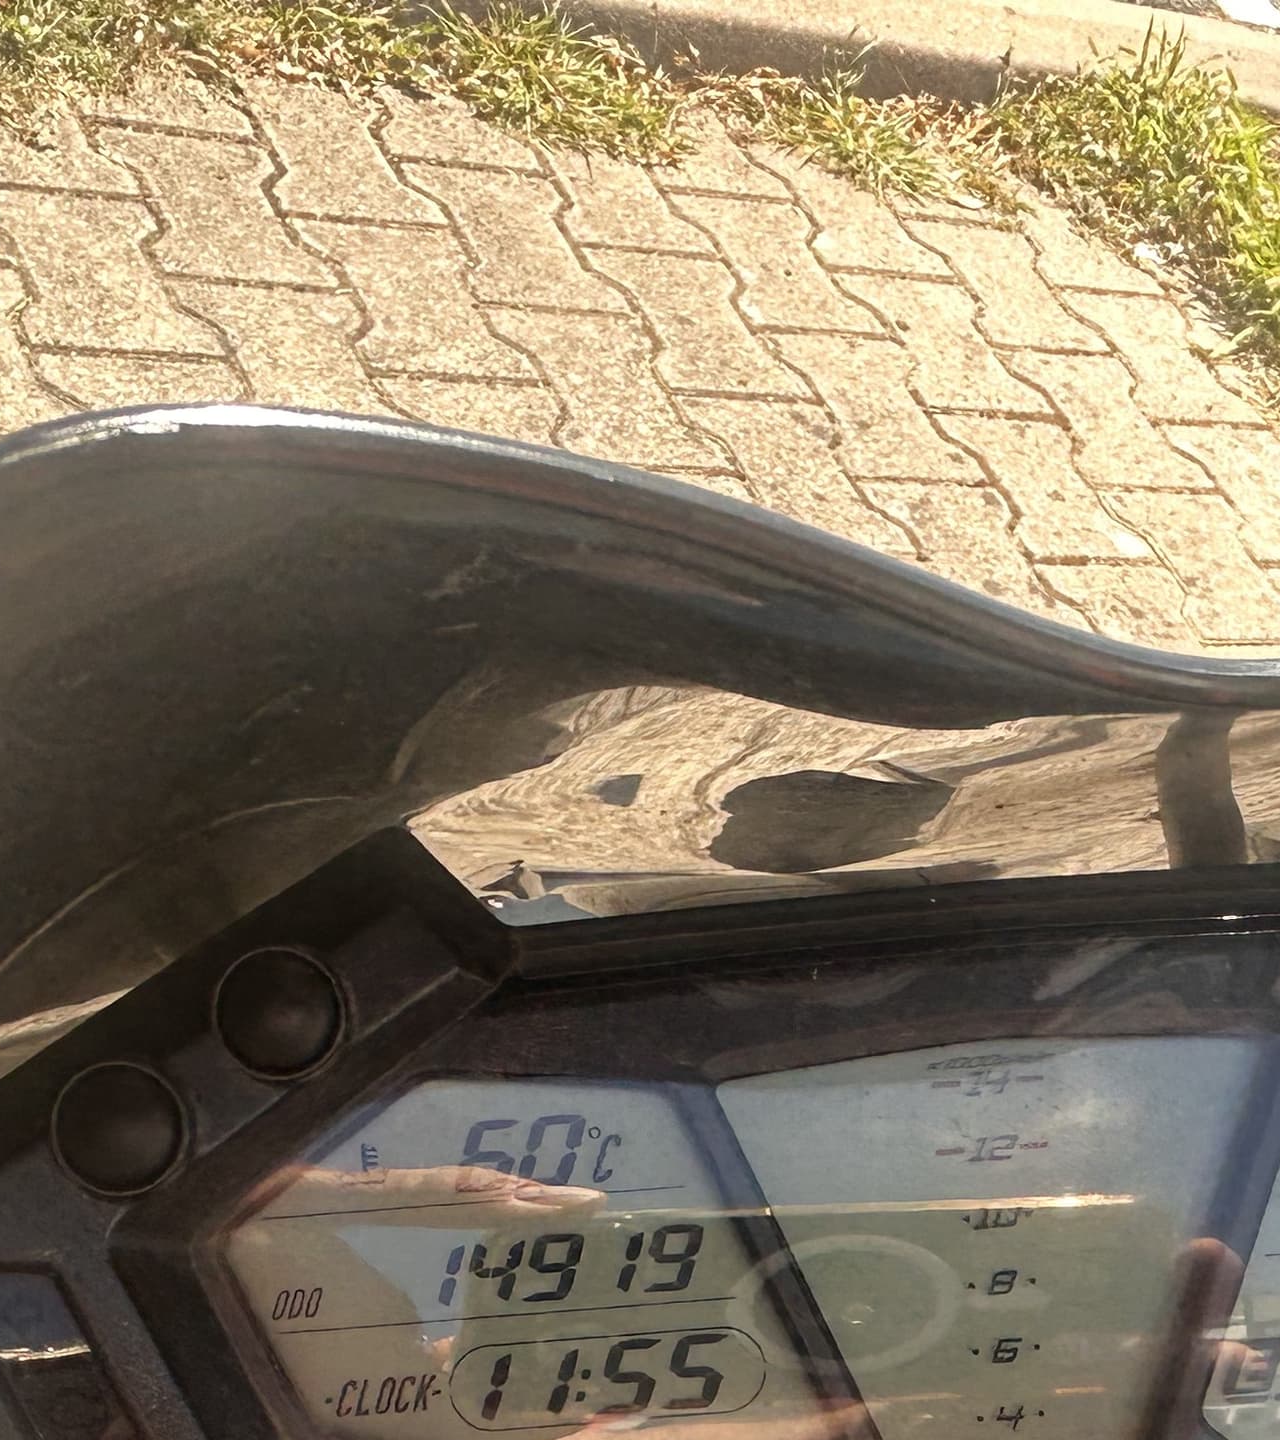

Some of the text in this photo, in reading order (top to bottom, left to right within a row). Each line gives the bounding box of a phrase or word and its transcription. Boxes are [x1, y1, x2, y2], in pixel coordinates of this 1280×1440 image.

[437, 1223, 704, 1307] 14919
[988, 1269, 1019, 1296] 8
[271, 1287, 323, 1322] ODO
[991, 1337, 1023, 1364] 6
[480, 1332, 729, 1422] 11:55
[995, 1405, 1025, 1431] 4
